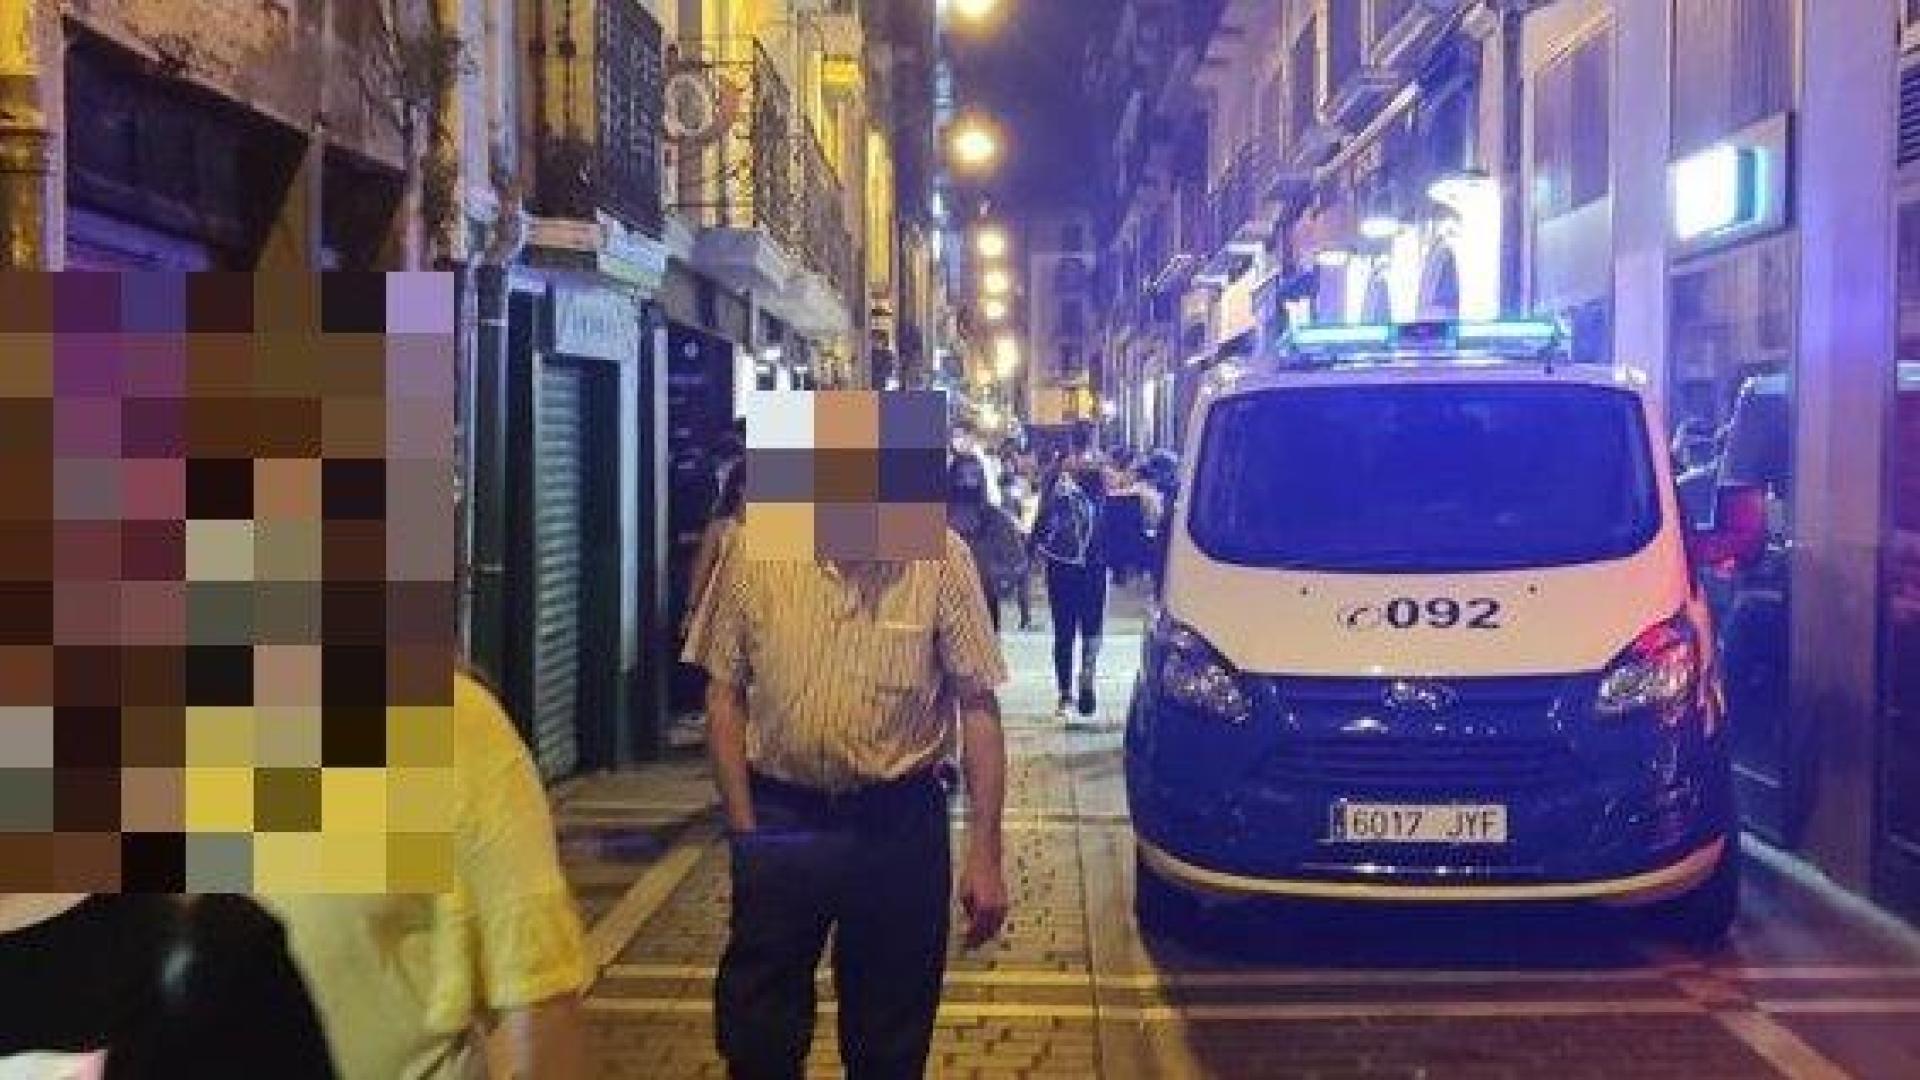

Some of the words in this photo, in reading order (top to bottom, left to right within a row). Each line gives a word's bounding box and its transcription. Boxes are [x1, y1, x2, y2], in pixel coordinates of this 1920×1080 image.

[1387, 597, 1501, 629] 092
[1352, 810, 1424, 837] 6017
[1446, 810, 1498, 837] JYF
